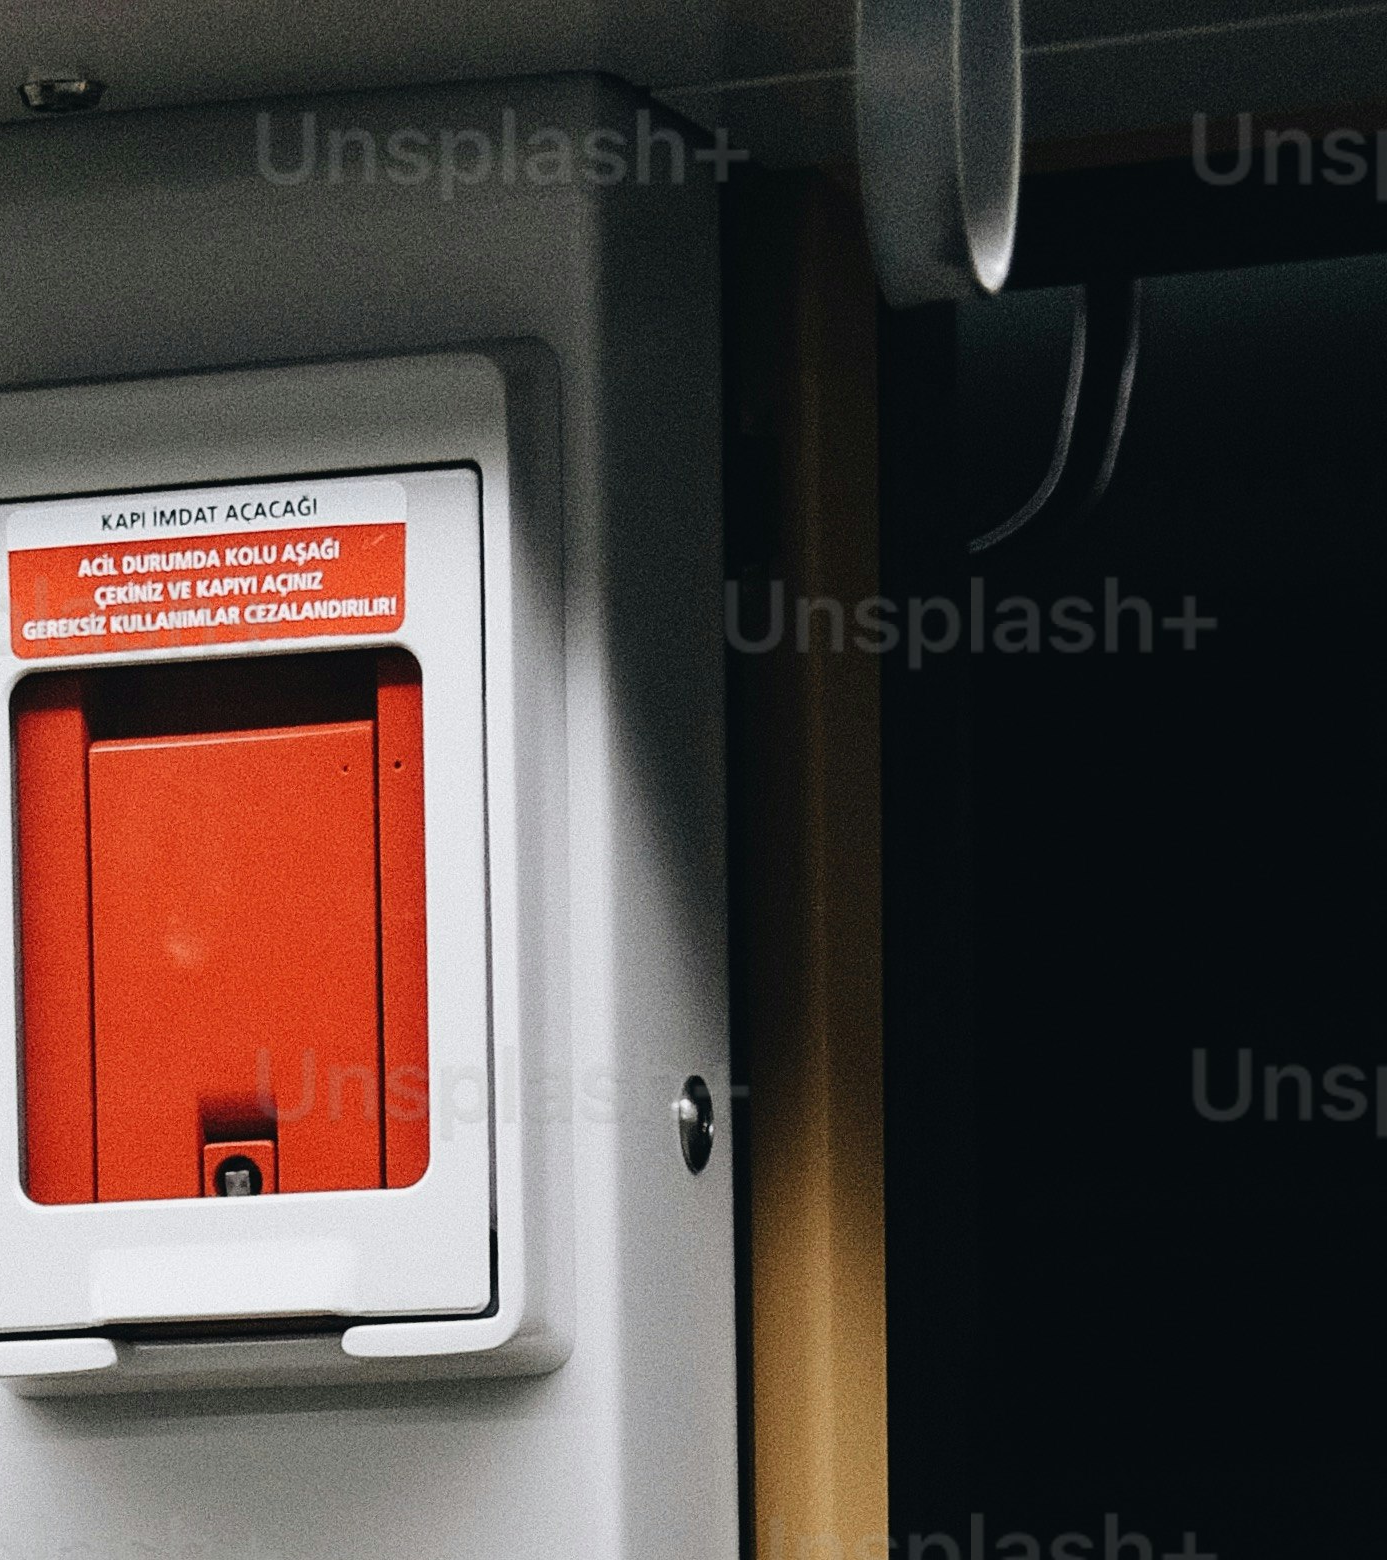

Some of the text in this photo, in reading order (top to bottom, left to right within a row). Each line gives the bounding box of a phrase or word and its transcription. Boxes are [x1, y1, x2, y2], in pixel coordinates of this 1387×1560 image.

[101, 496, 318, 531] KAPI İMDAT AÇACAĞI
[78, 537, 340, 578] ACİL DURUMDA KOLU AŞAĞI
[94, 571, 323, 610] ÇEKİNİZ VE KAPIYI AÇINIZ
[22, 596, 397, 641] GEREKSİZ KULLANIMLAR CEZALANDIRILIR!
